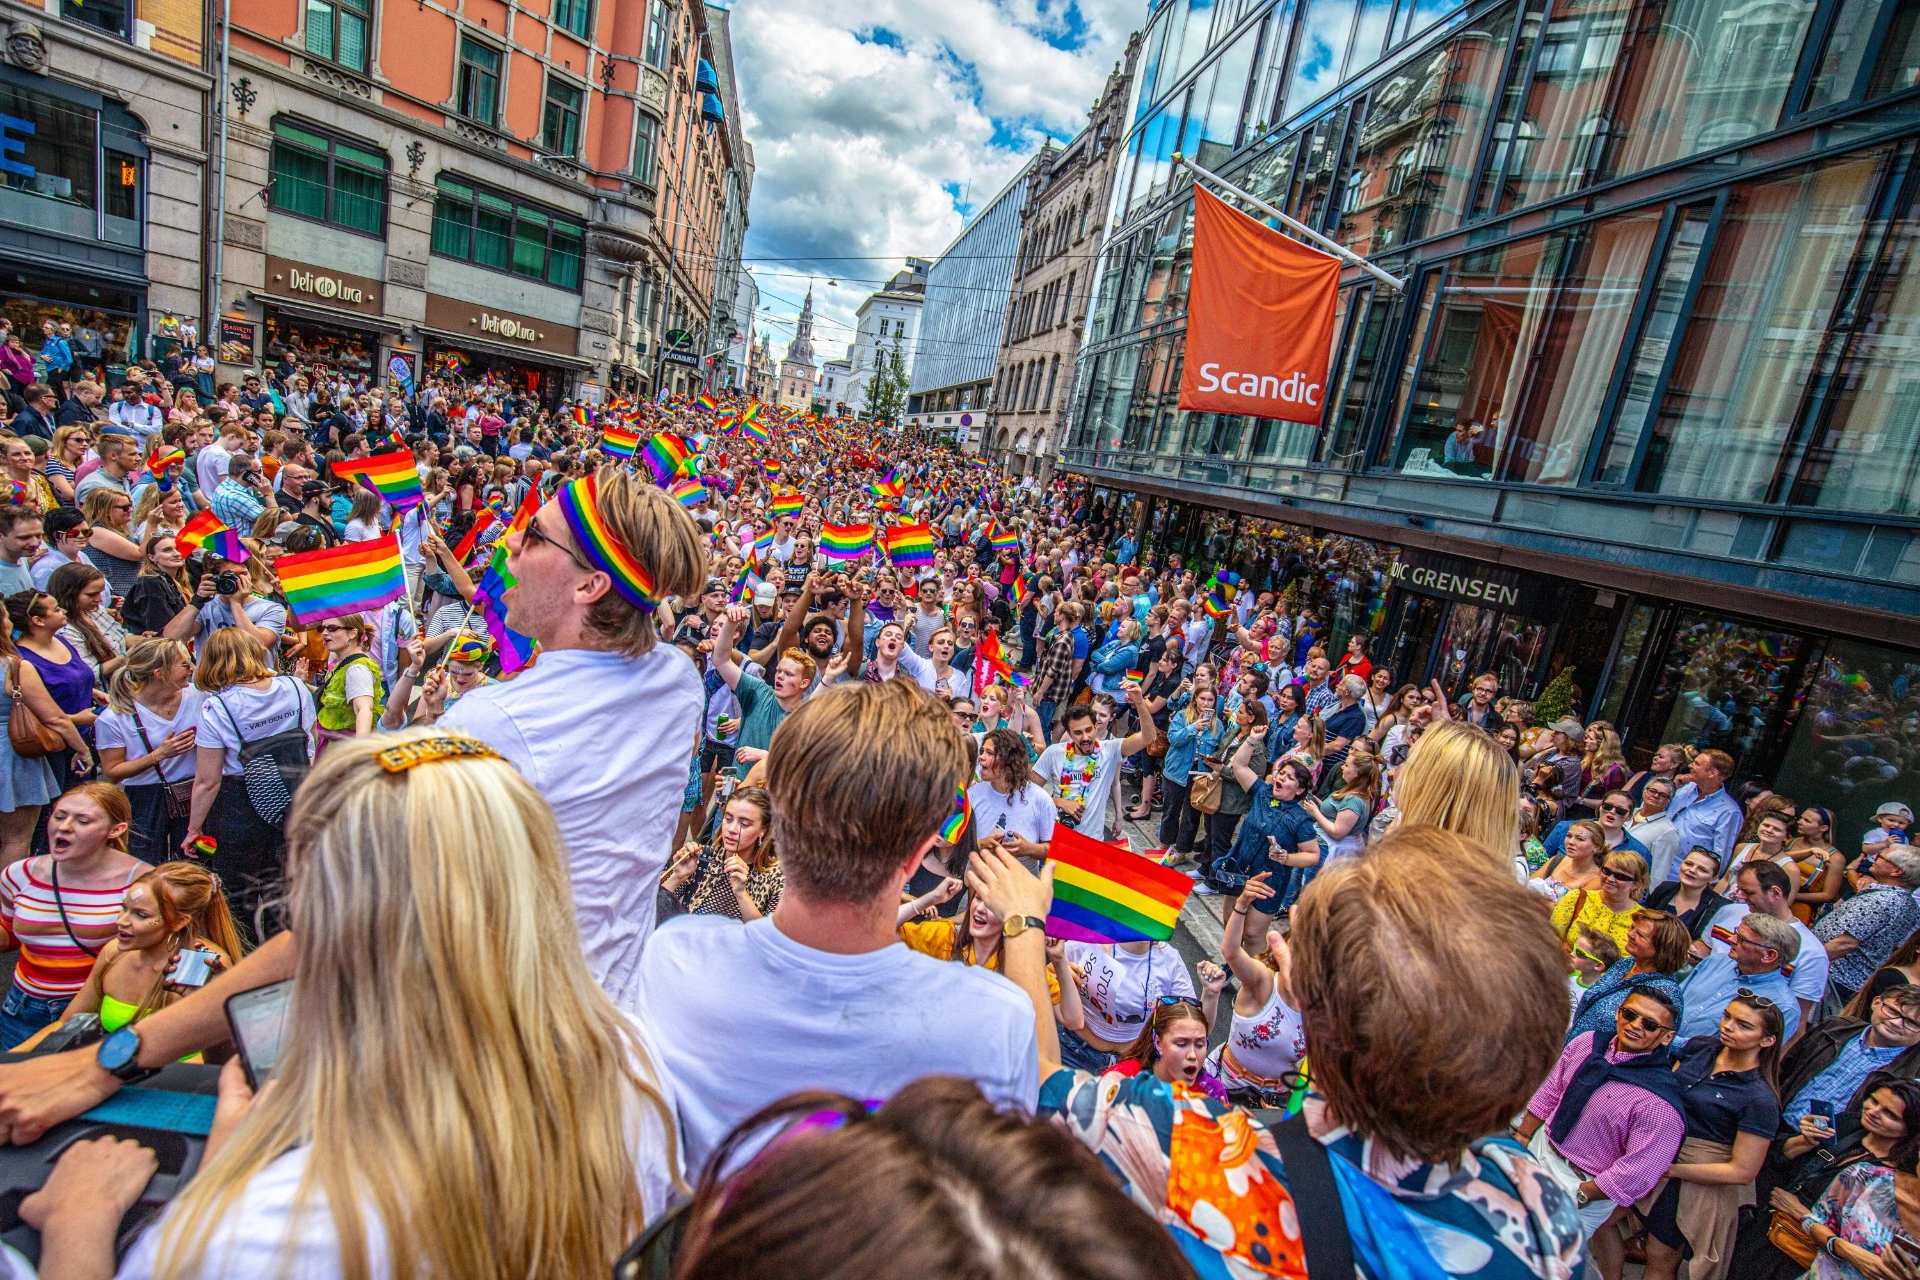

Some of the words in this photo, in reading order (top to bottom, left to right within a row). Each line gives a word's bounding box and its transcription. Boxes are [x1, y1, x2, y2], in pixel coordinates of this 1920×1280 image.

[290, 268, 314, 293] Deli
[337, 279, 362, 303] Luca
[481, 313, 500, 333] Deli
[516, 321, 535, 341] Luca
[1197, 362, 1320, 406] Scandic
[1390, 562, 1410, 581] DIC
[1412, 568, 1519, 606] GRENSEN
[249, 721, 267, 730] VÆR
[268, 715, 283, 724] DEN
[284, 710, 295, 719] DU
[1096, 965, 1114, 1009] STOLT
